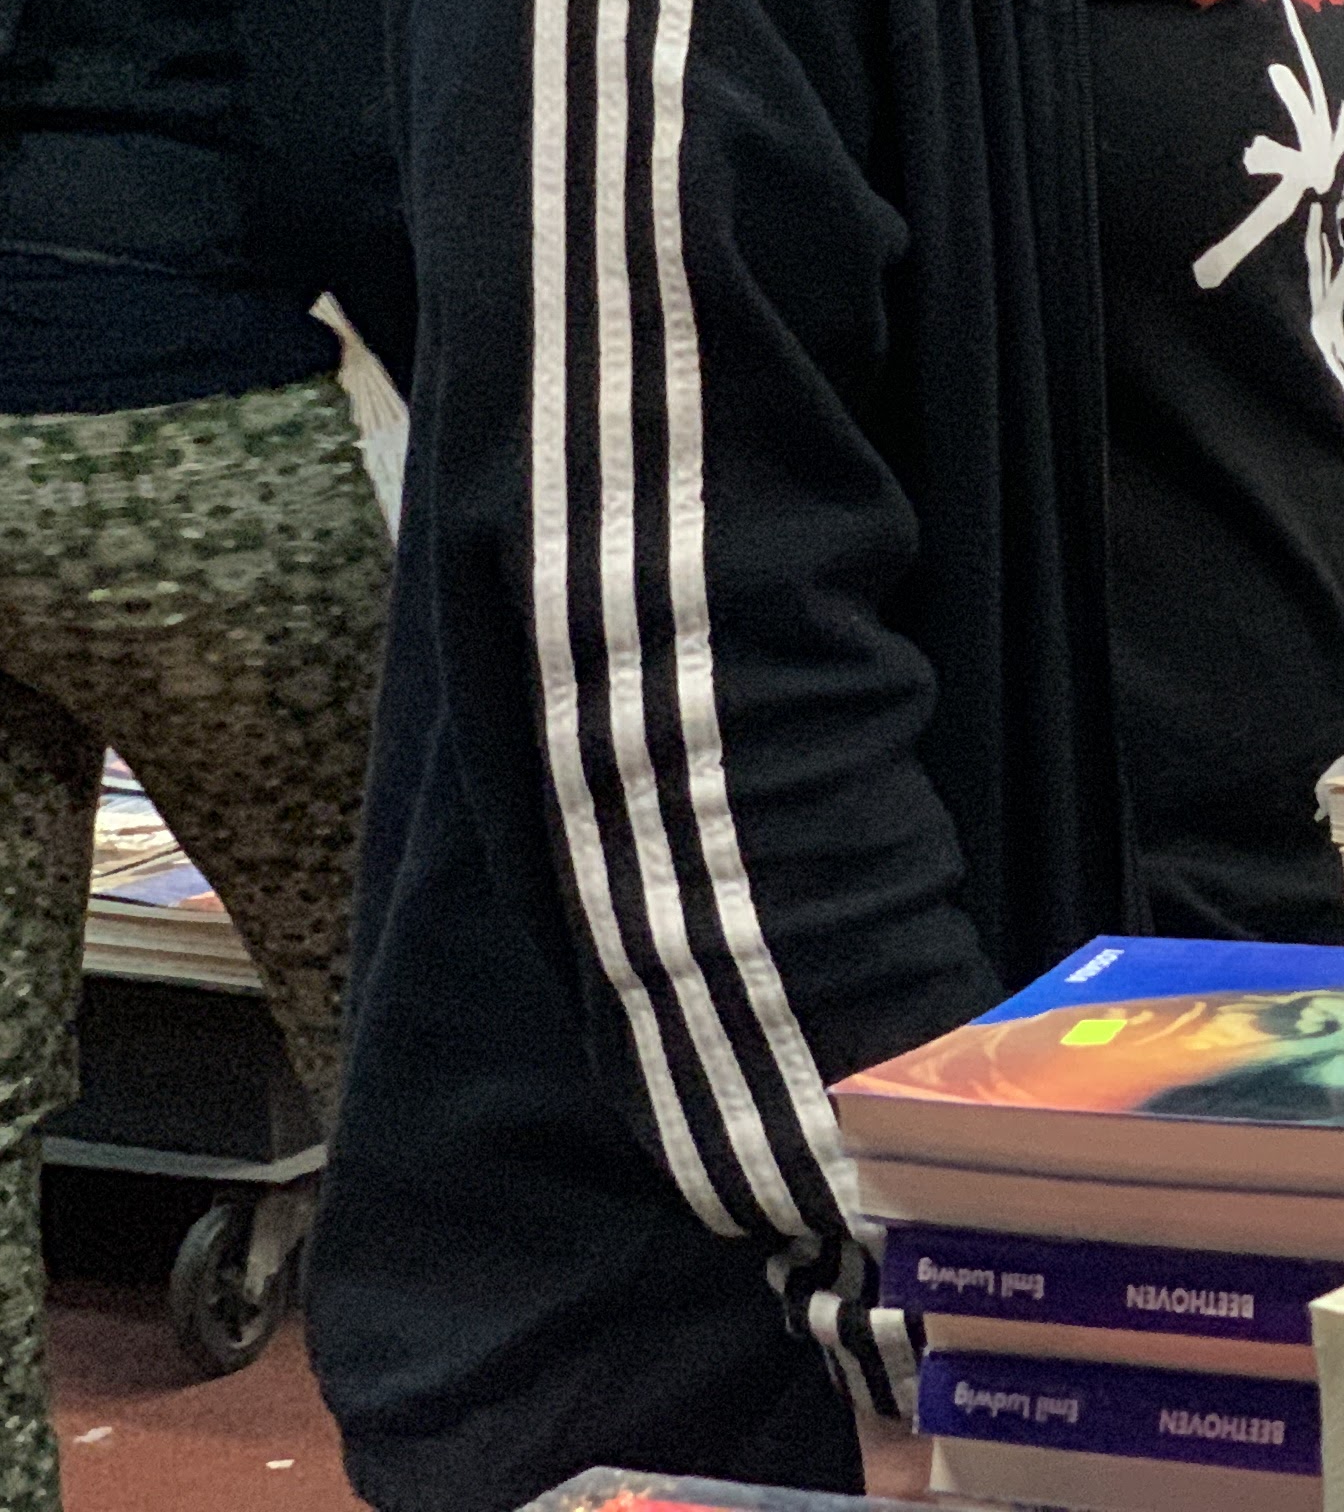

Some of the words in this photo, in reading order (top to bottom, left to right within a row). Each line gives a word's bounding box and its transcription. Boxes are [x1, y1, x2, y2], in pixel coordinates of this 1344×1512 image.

[917, 1257, 994, 1295] Ludwig
[1001, 1272, 1044, 1300] Emil
[1127, 1284, 1255, 1320] BEETHOVEN
[954, 1382, 1030, 1420] Ludwig
[1035, 1397, 1079, 1424] Emil
[1159, 1410, 1286, 1446] BEETHOVEN
